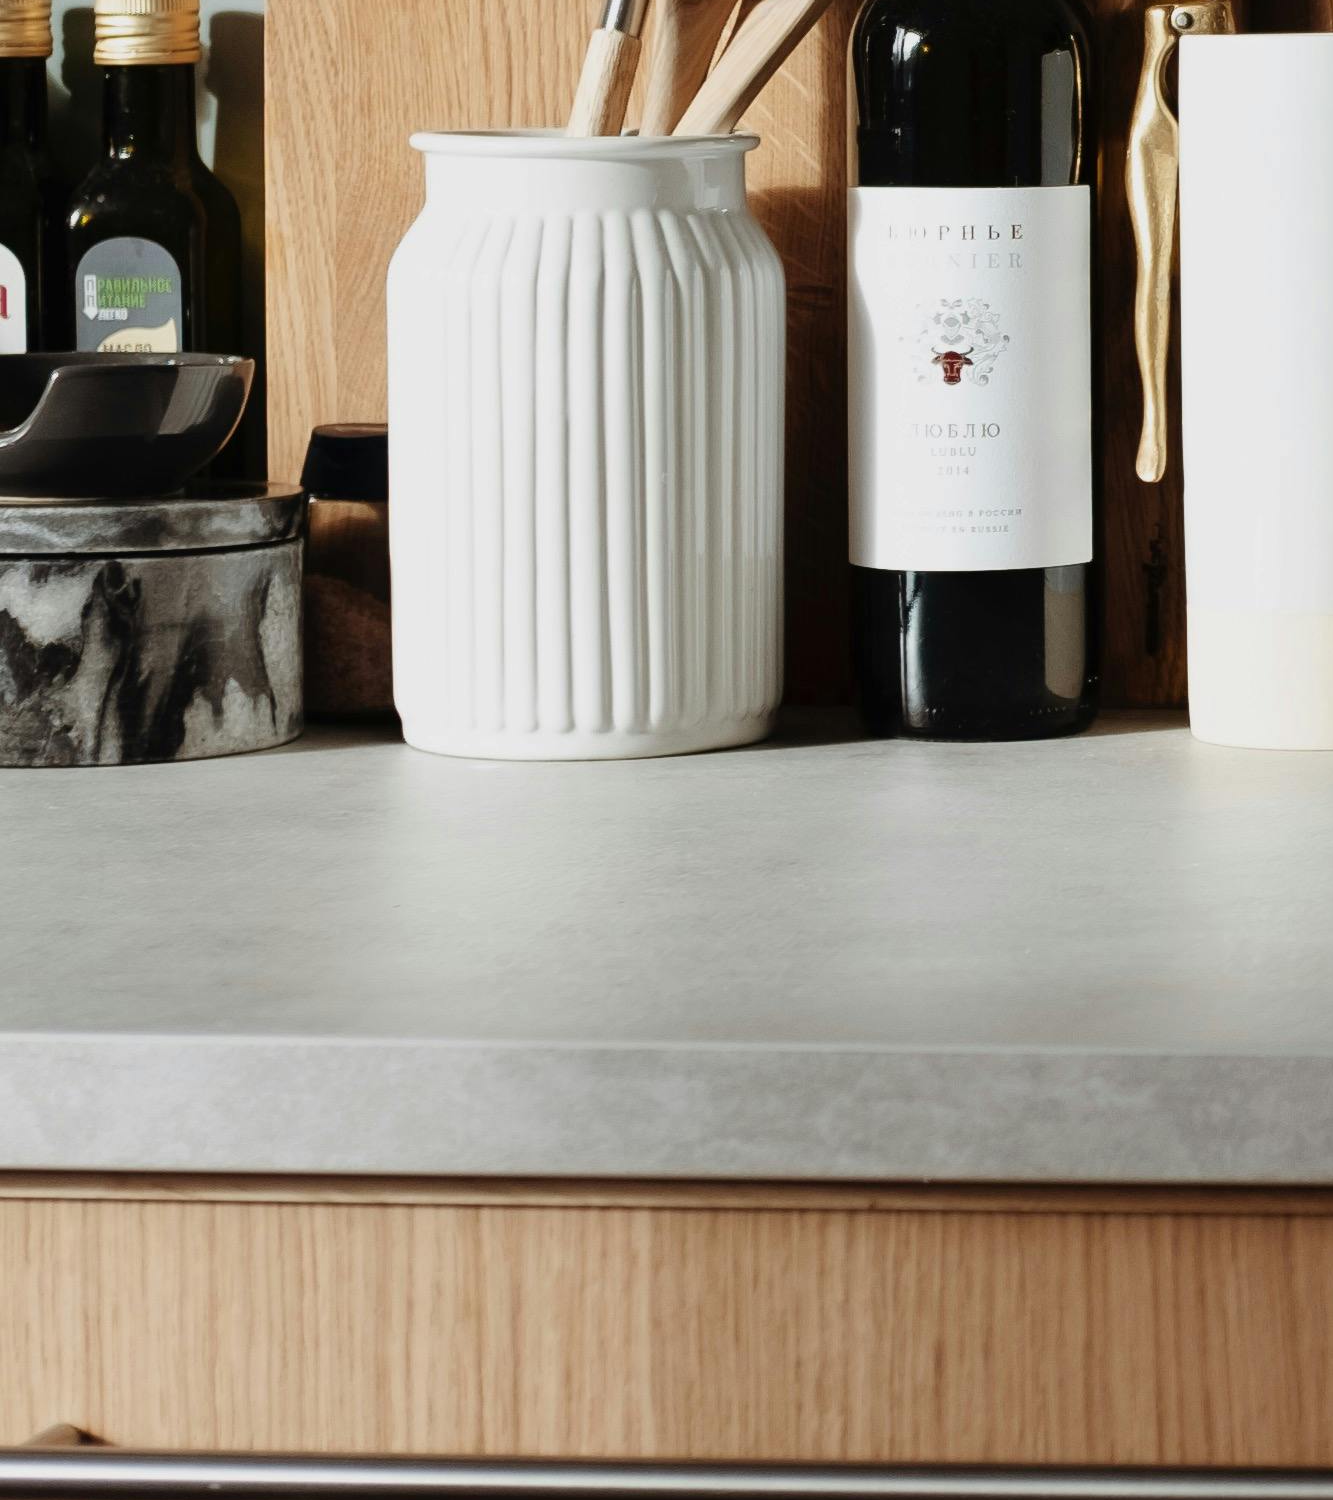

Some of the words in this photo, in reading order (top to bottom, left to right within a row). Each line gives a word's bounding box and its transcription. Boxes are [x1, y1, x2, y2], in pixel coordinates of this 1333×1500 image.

[85, 276, 173, 294] ПРАВИЛЬНОЕ
[85, 293, 146, 309] ПИТАНИЕ
[908, 422, 1001, 440] ЛЮБЛЮ
